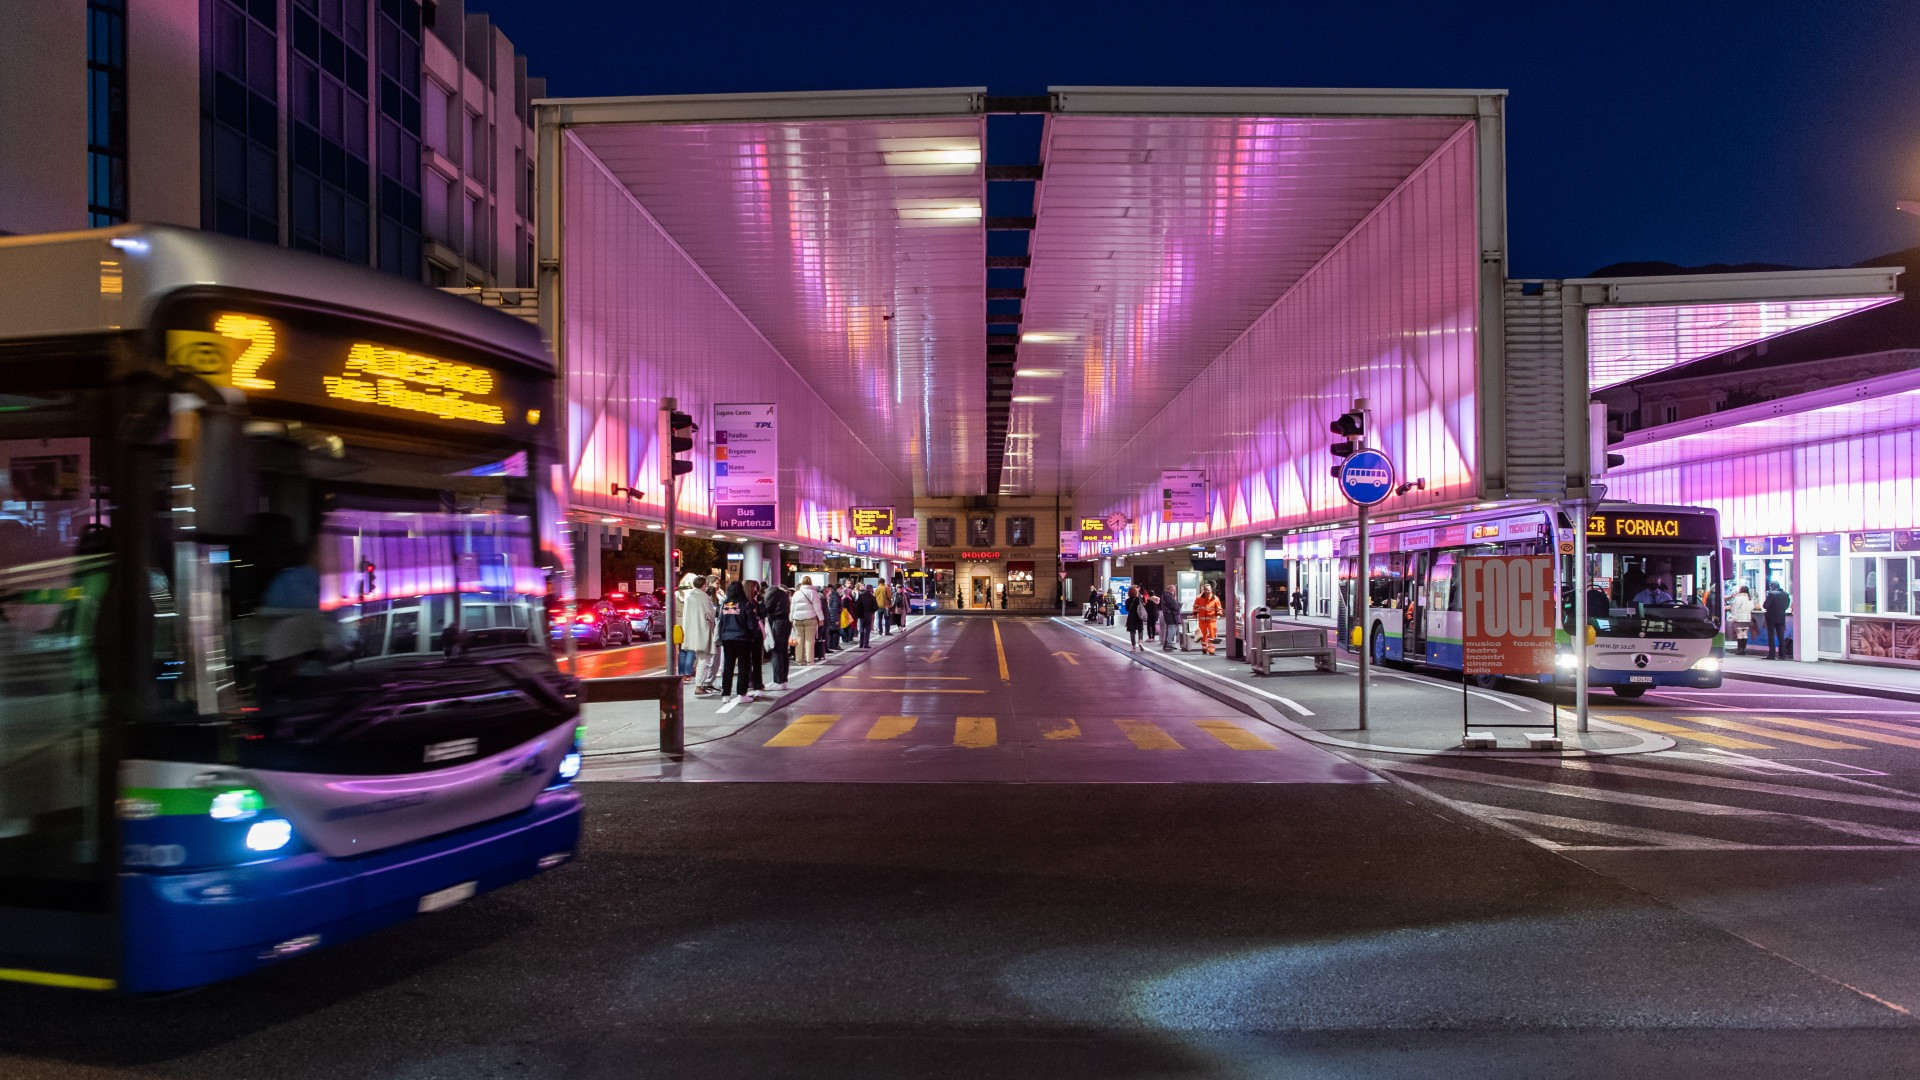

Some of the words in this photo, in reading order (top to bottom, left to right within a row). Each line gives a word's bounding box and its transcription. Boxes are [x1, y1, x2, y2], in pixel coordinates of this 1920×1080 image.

[215, 315, 275, 389] 2
[737, 508, 755, 516] Bus
[720, 519, 728, 527] in
[731, 519, 772, 527] Partenza
[1616, 519, 1679, 536] FORNACI
[1465, 558, 1552, 637] FOCE
[1652, 641, 1680, 651] TPL
